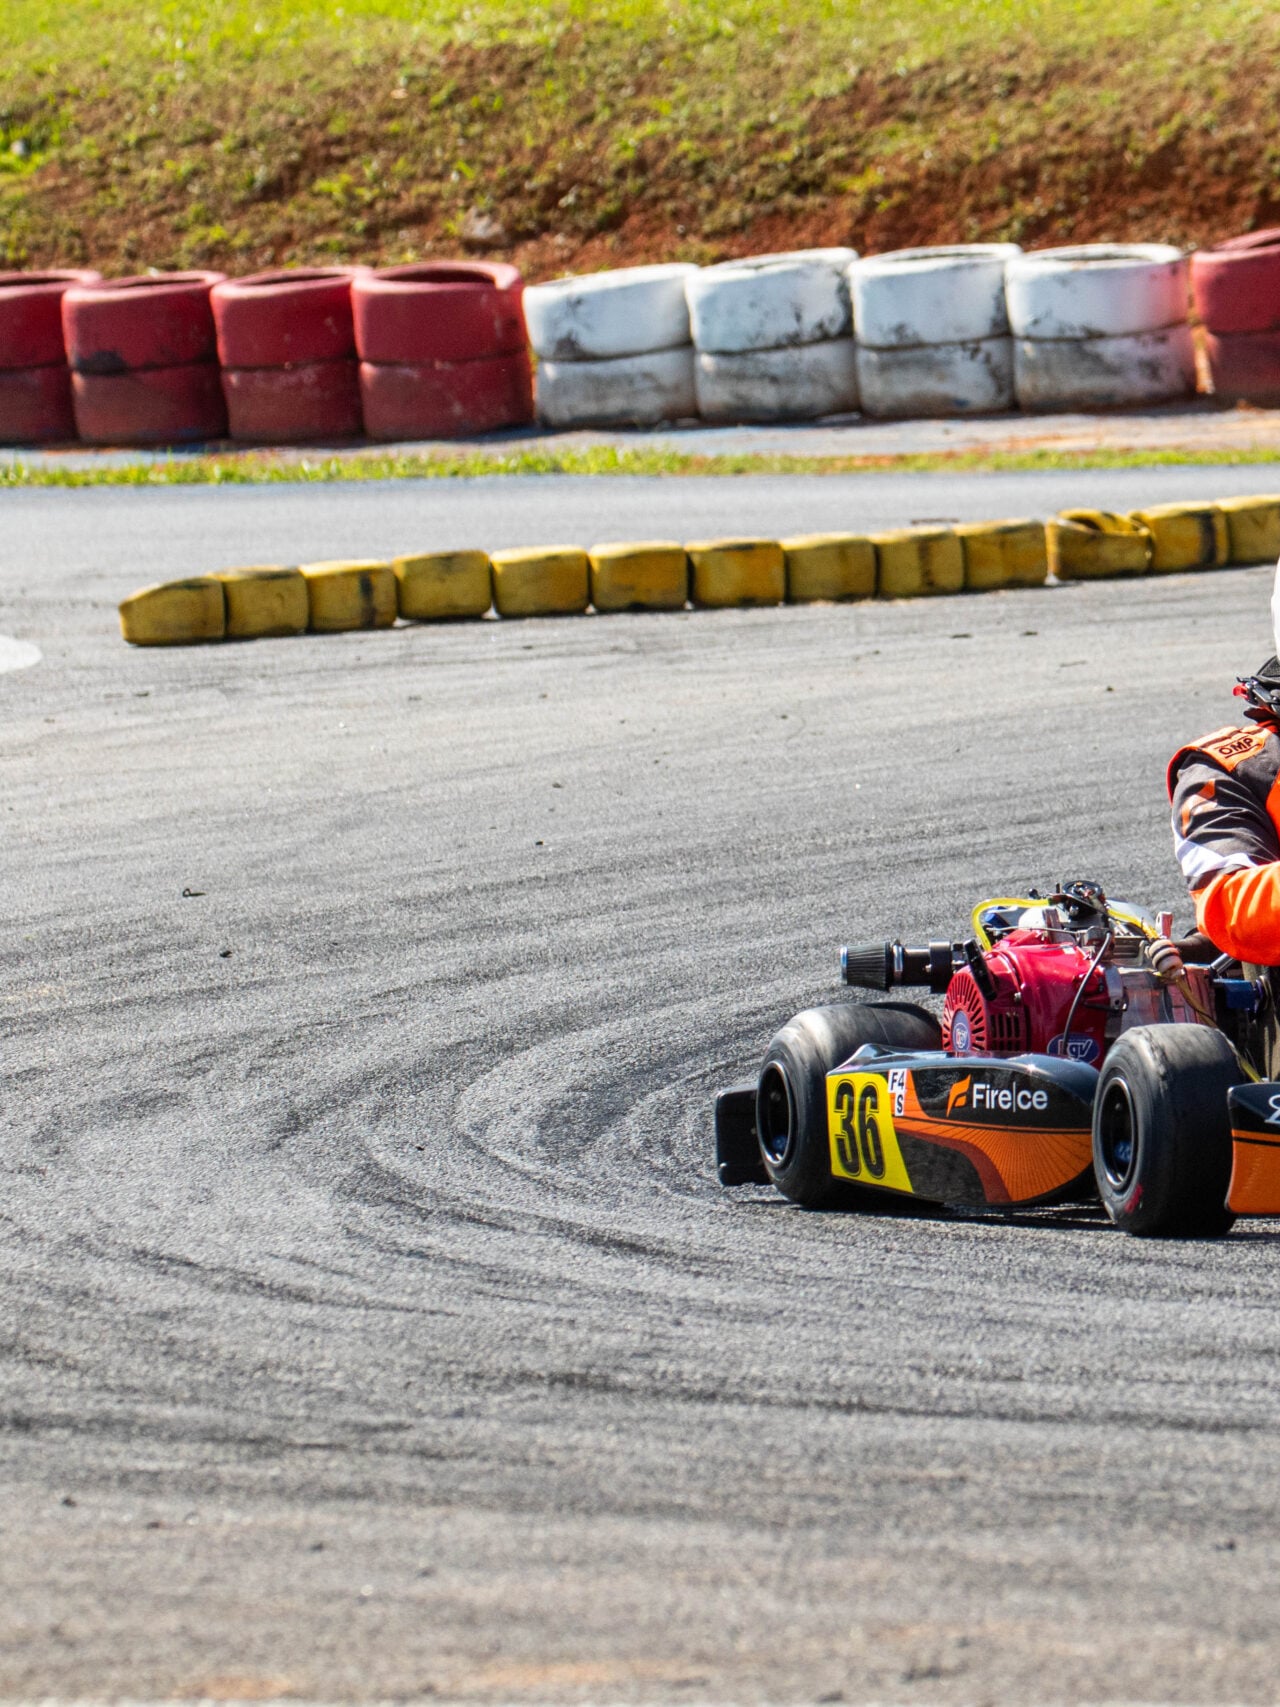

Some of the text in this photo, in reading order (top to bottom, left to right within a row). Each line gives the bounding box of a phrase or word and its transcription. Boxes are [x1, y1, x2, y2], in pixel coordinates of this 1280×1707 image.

[1218, 737, 1254, 756] OMP
[890, 1071, 905, 1091] F4
[896, 1094, 904, 1114] S
[834, 1079, 885, 1179] 36
